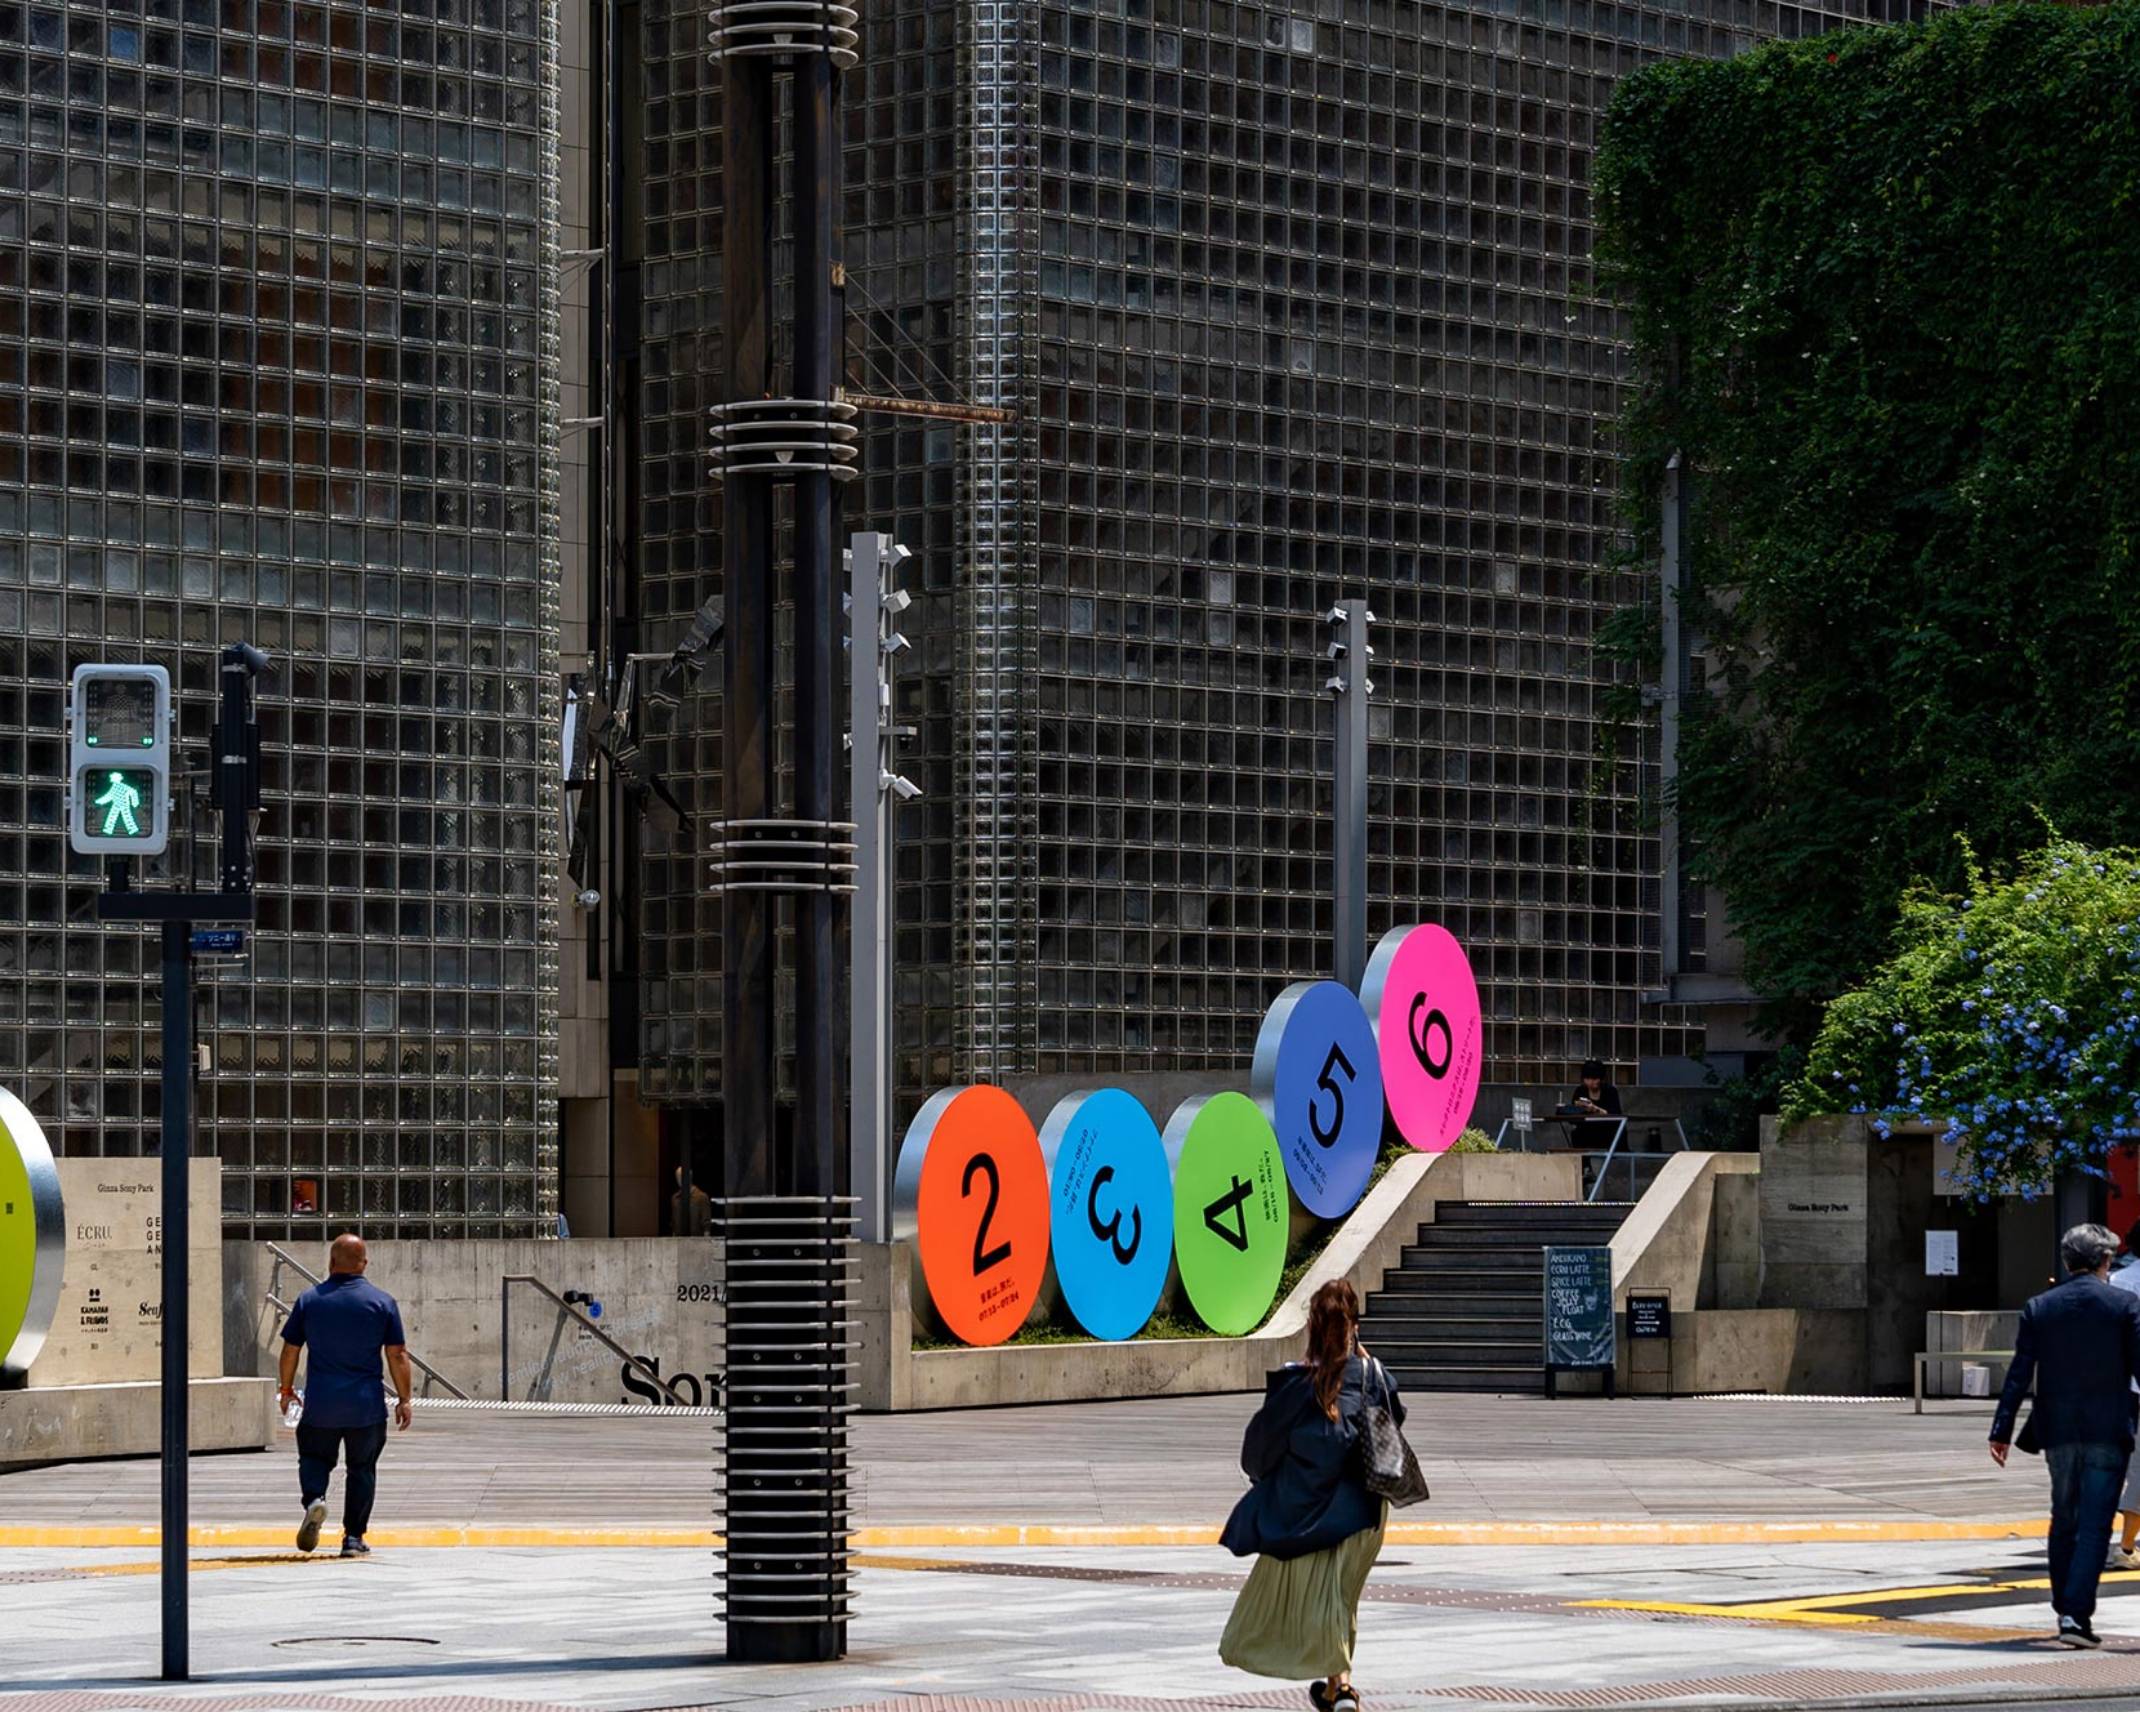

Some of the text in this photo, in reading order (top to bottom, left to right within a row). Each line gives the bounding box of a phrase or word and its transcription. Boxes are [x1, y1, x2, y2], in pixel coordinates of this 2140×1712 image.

[1410, 993, 1451, 1079] 6
[1310, 1043, 1355, 1148] 5
[97, 1183, 154, 1194] Ginza Sony Park
[963, 1154, 1010, 1274] 2
[1089, 1167, 1140, 1264] 3
[1204, 1176, 1252, 1251] 4
